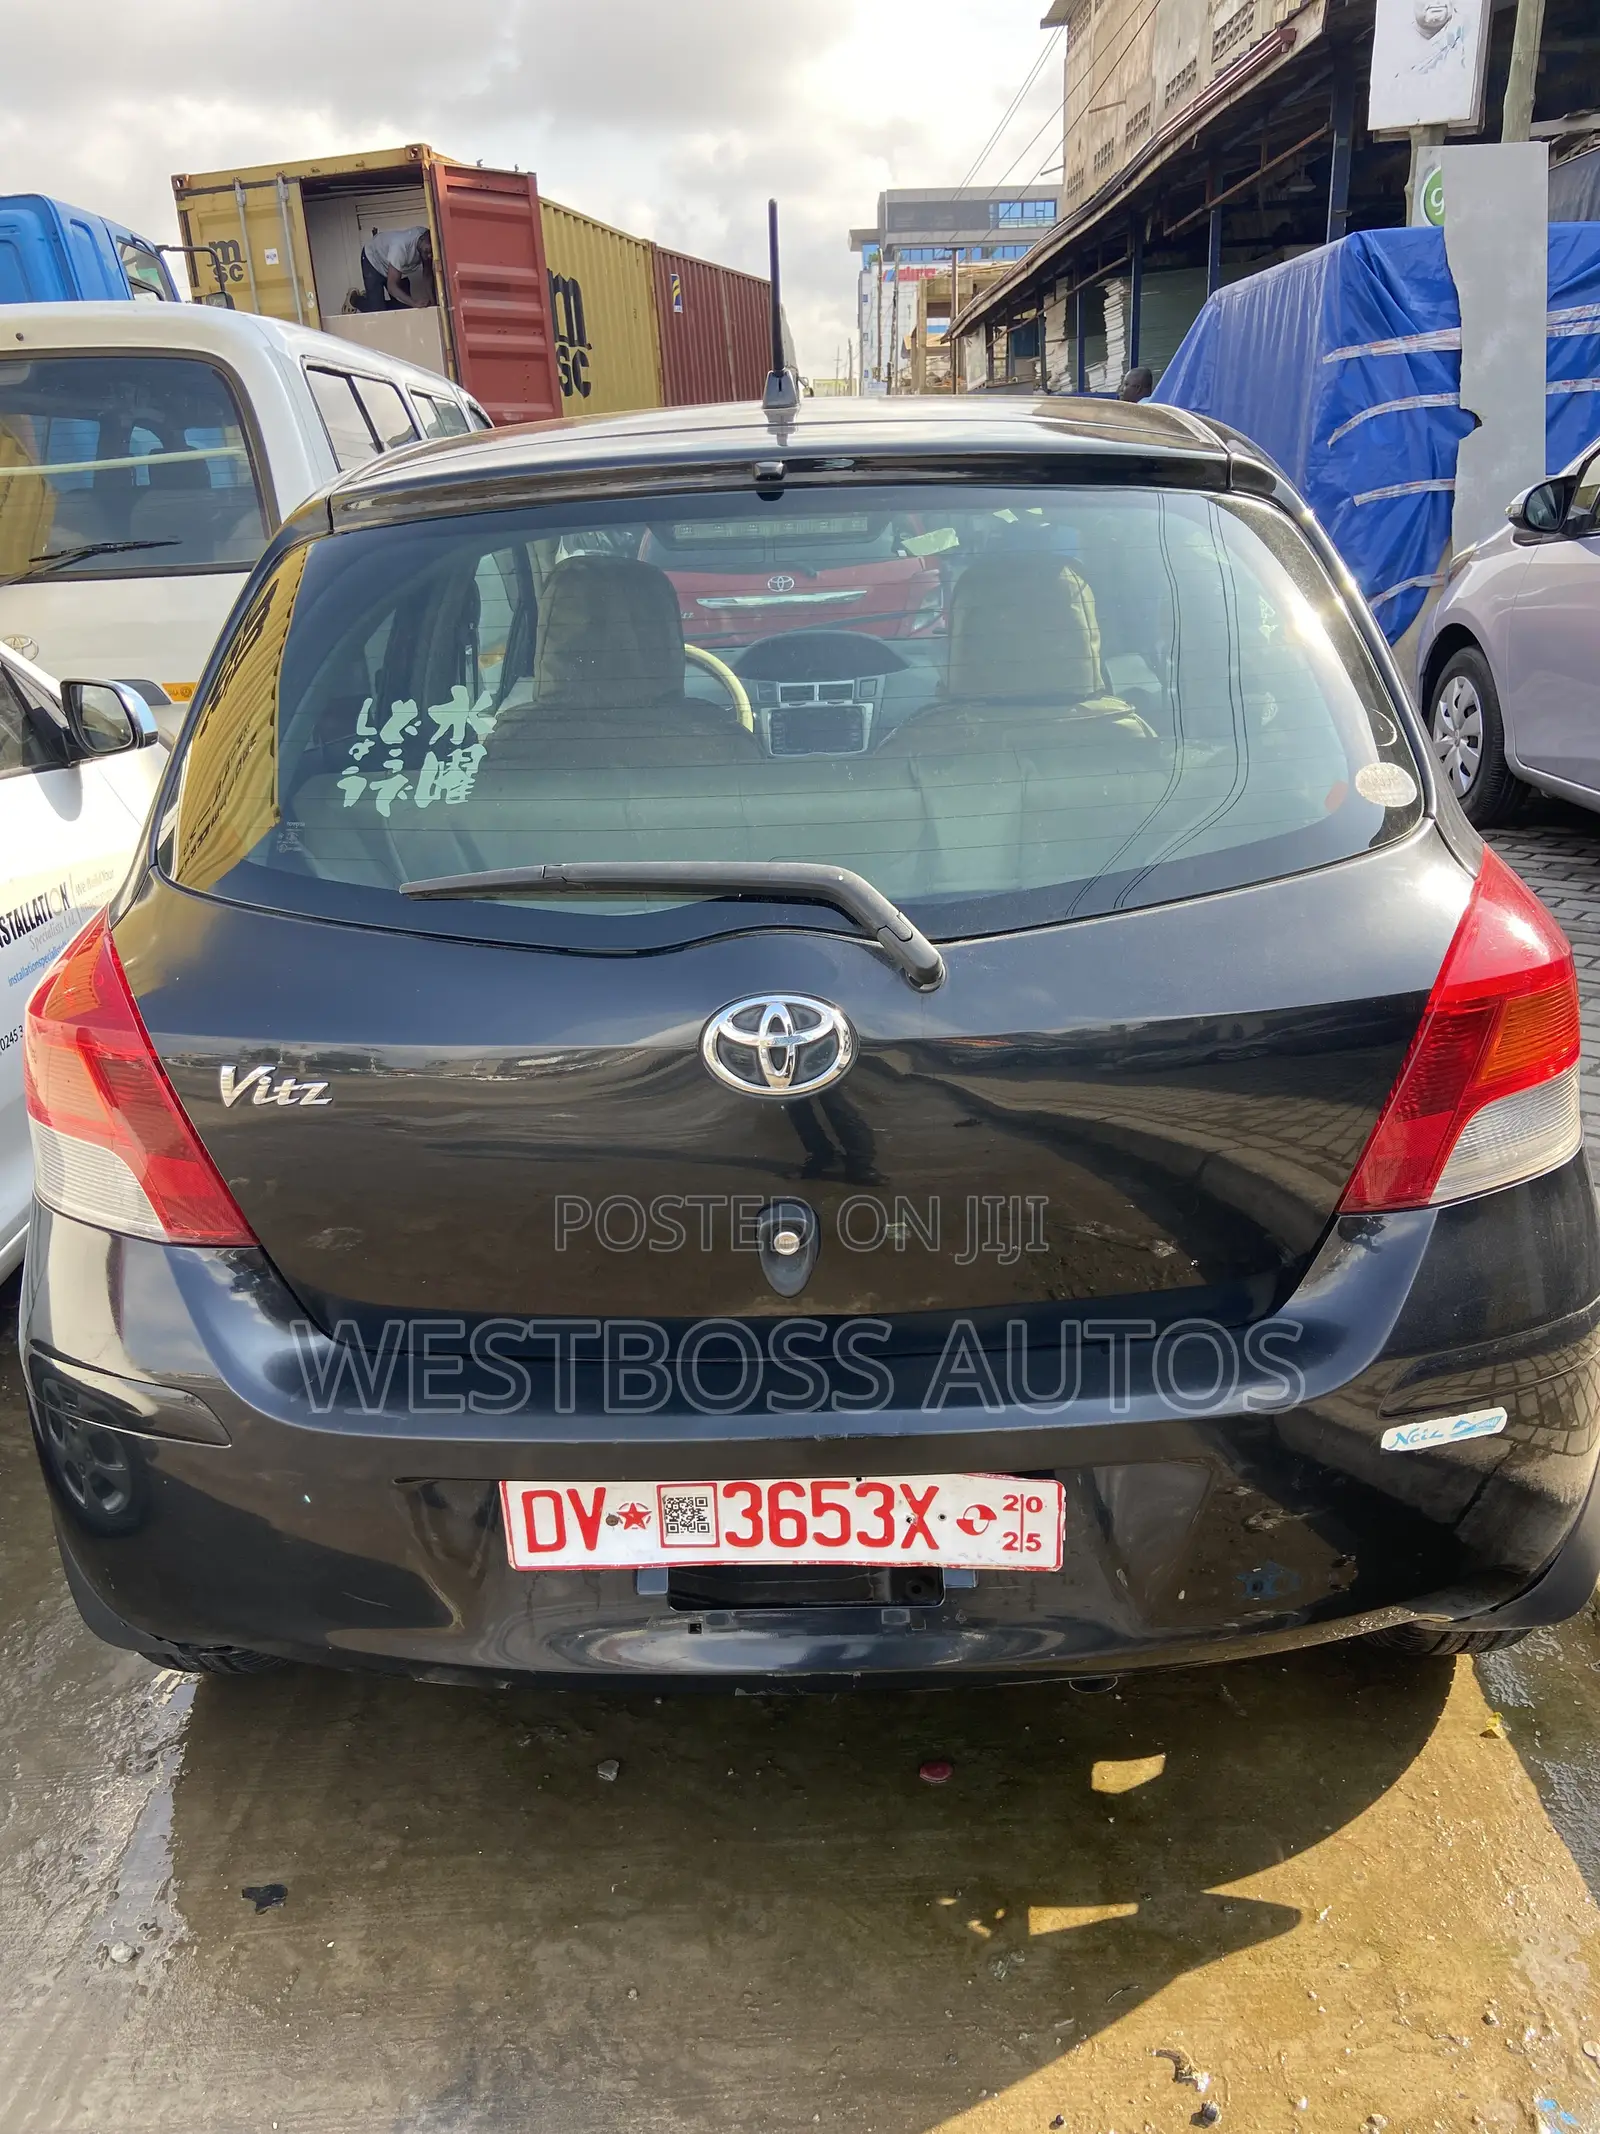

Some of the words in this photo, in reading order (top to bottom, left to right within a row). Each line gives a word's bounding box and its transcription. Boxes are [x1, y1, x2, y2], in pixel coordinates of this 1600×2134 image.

[0, 881, 71, 949] STALLATION
[220, 1064, 333, 1108] Vitz
[521, 1486, 607, 1553] DV
[722, 1481, 940, 1550] 3653X
